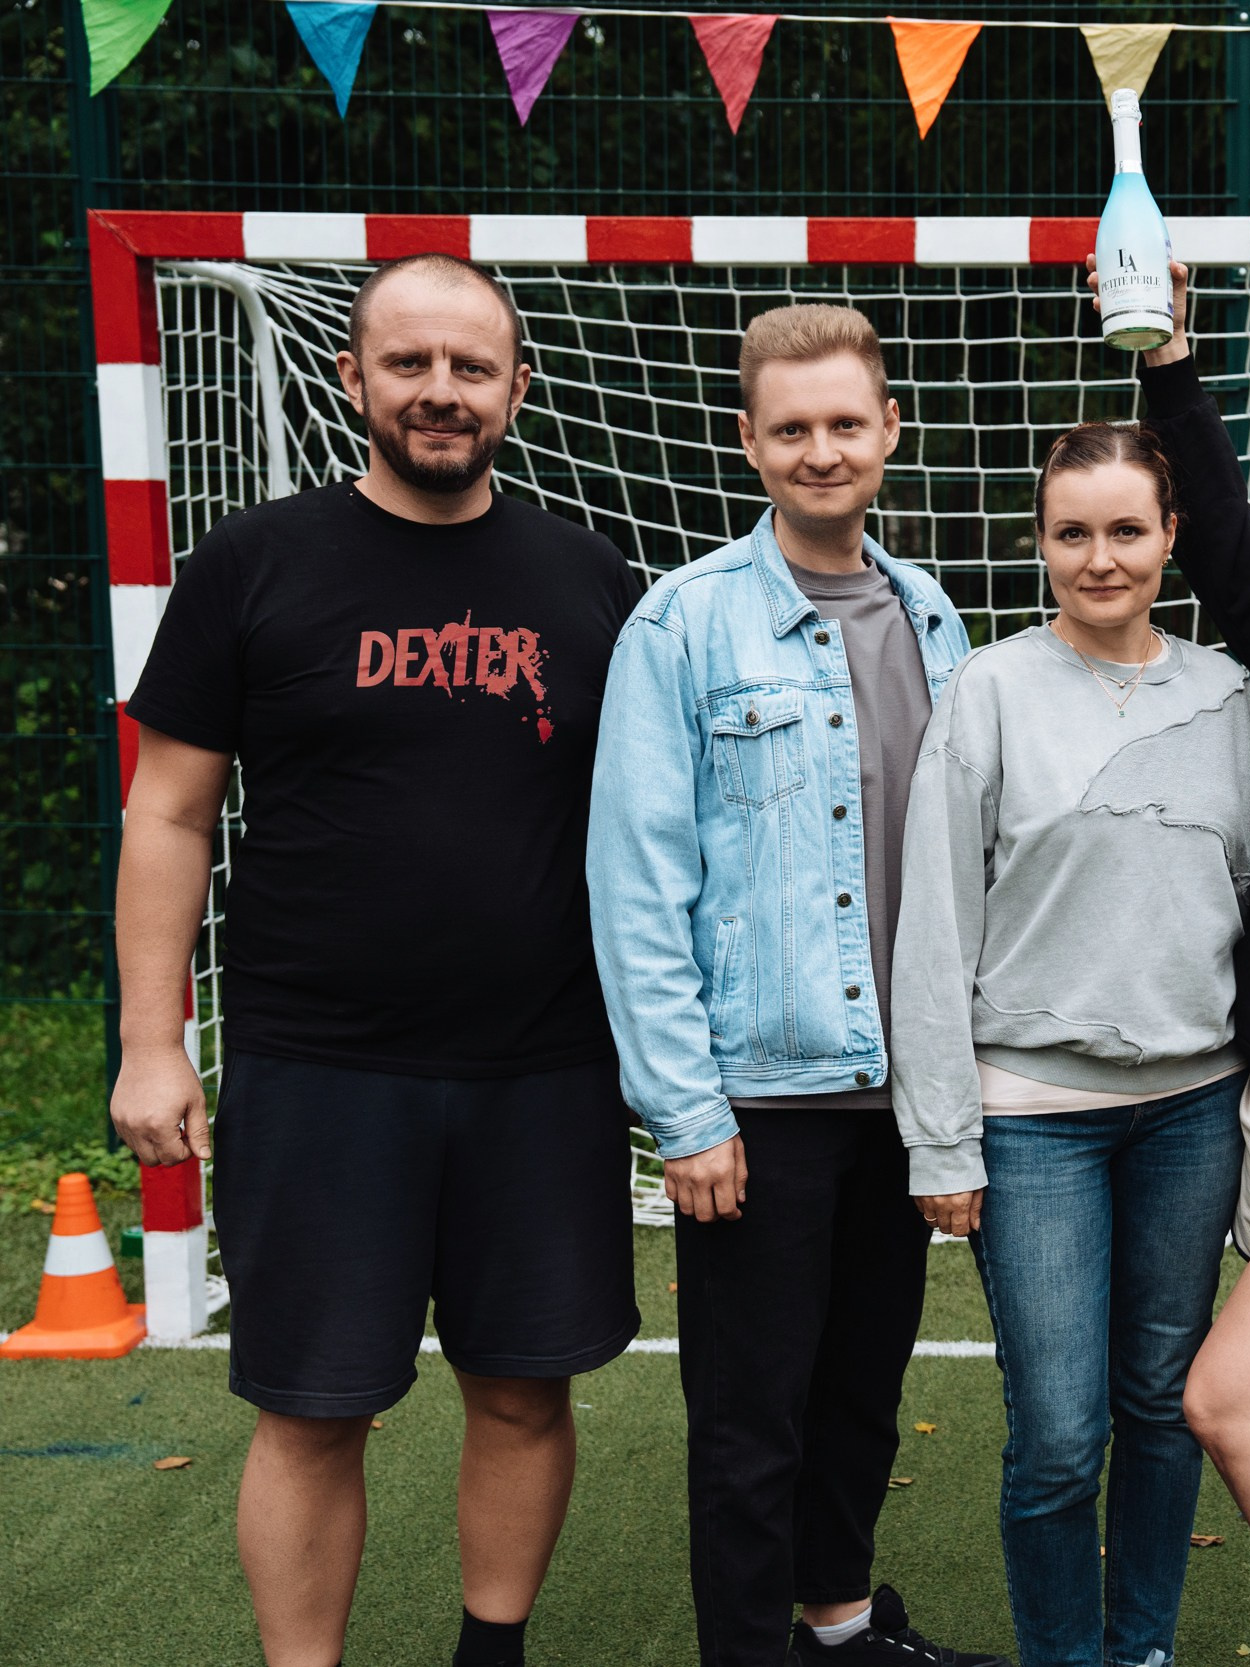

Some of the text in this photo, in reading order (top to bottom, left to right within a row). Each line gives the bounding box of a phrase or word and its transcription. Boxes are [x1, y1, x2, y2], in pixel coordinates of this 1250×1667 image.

[1101, 275, 1129, 293] PETITE
[1130, 275, 1161, 286] PERLE
[356, 622, 541, 700] DEXTER
